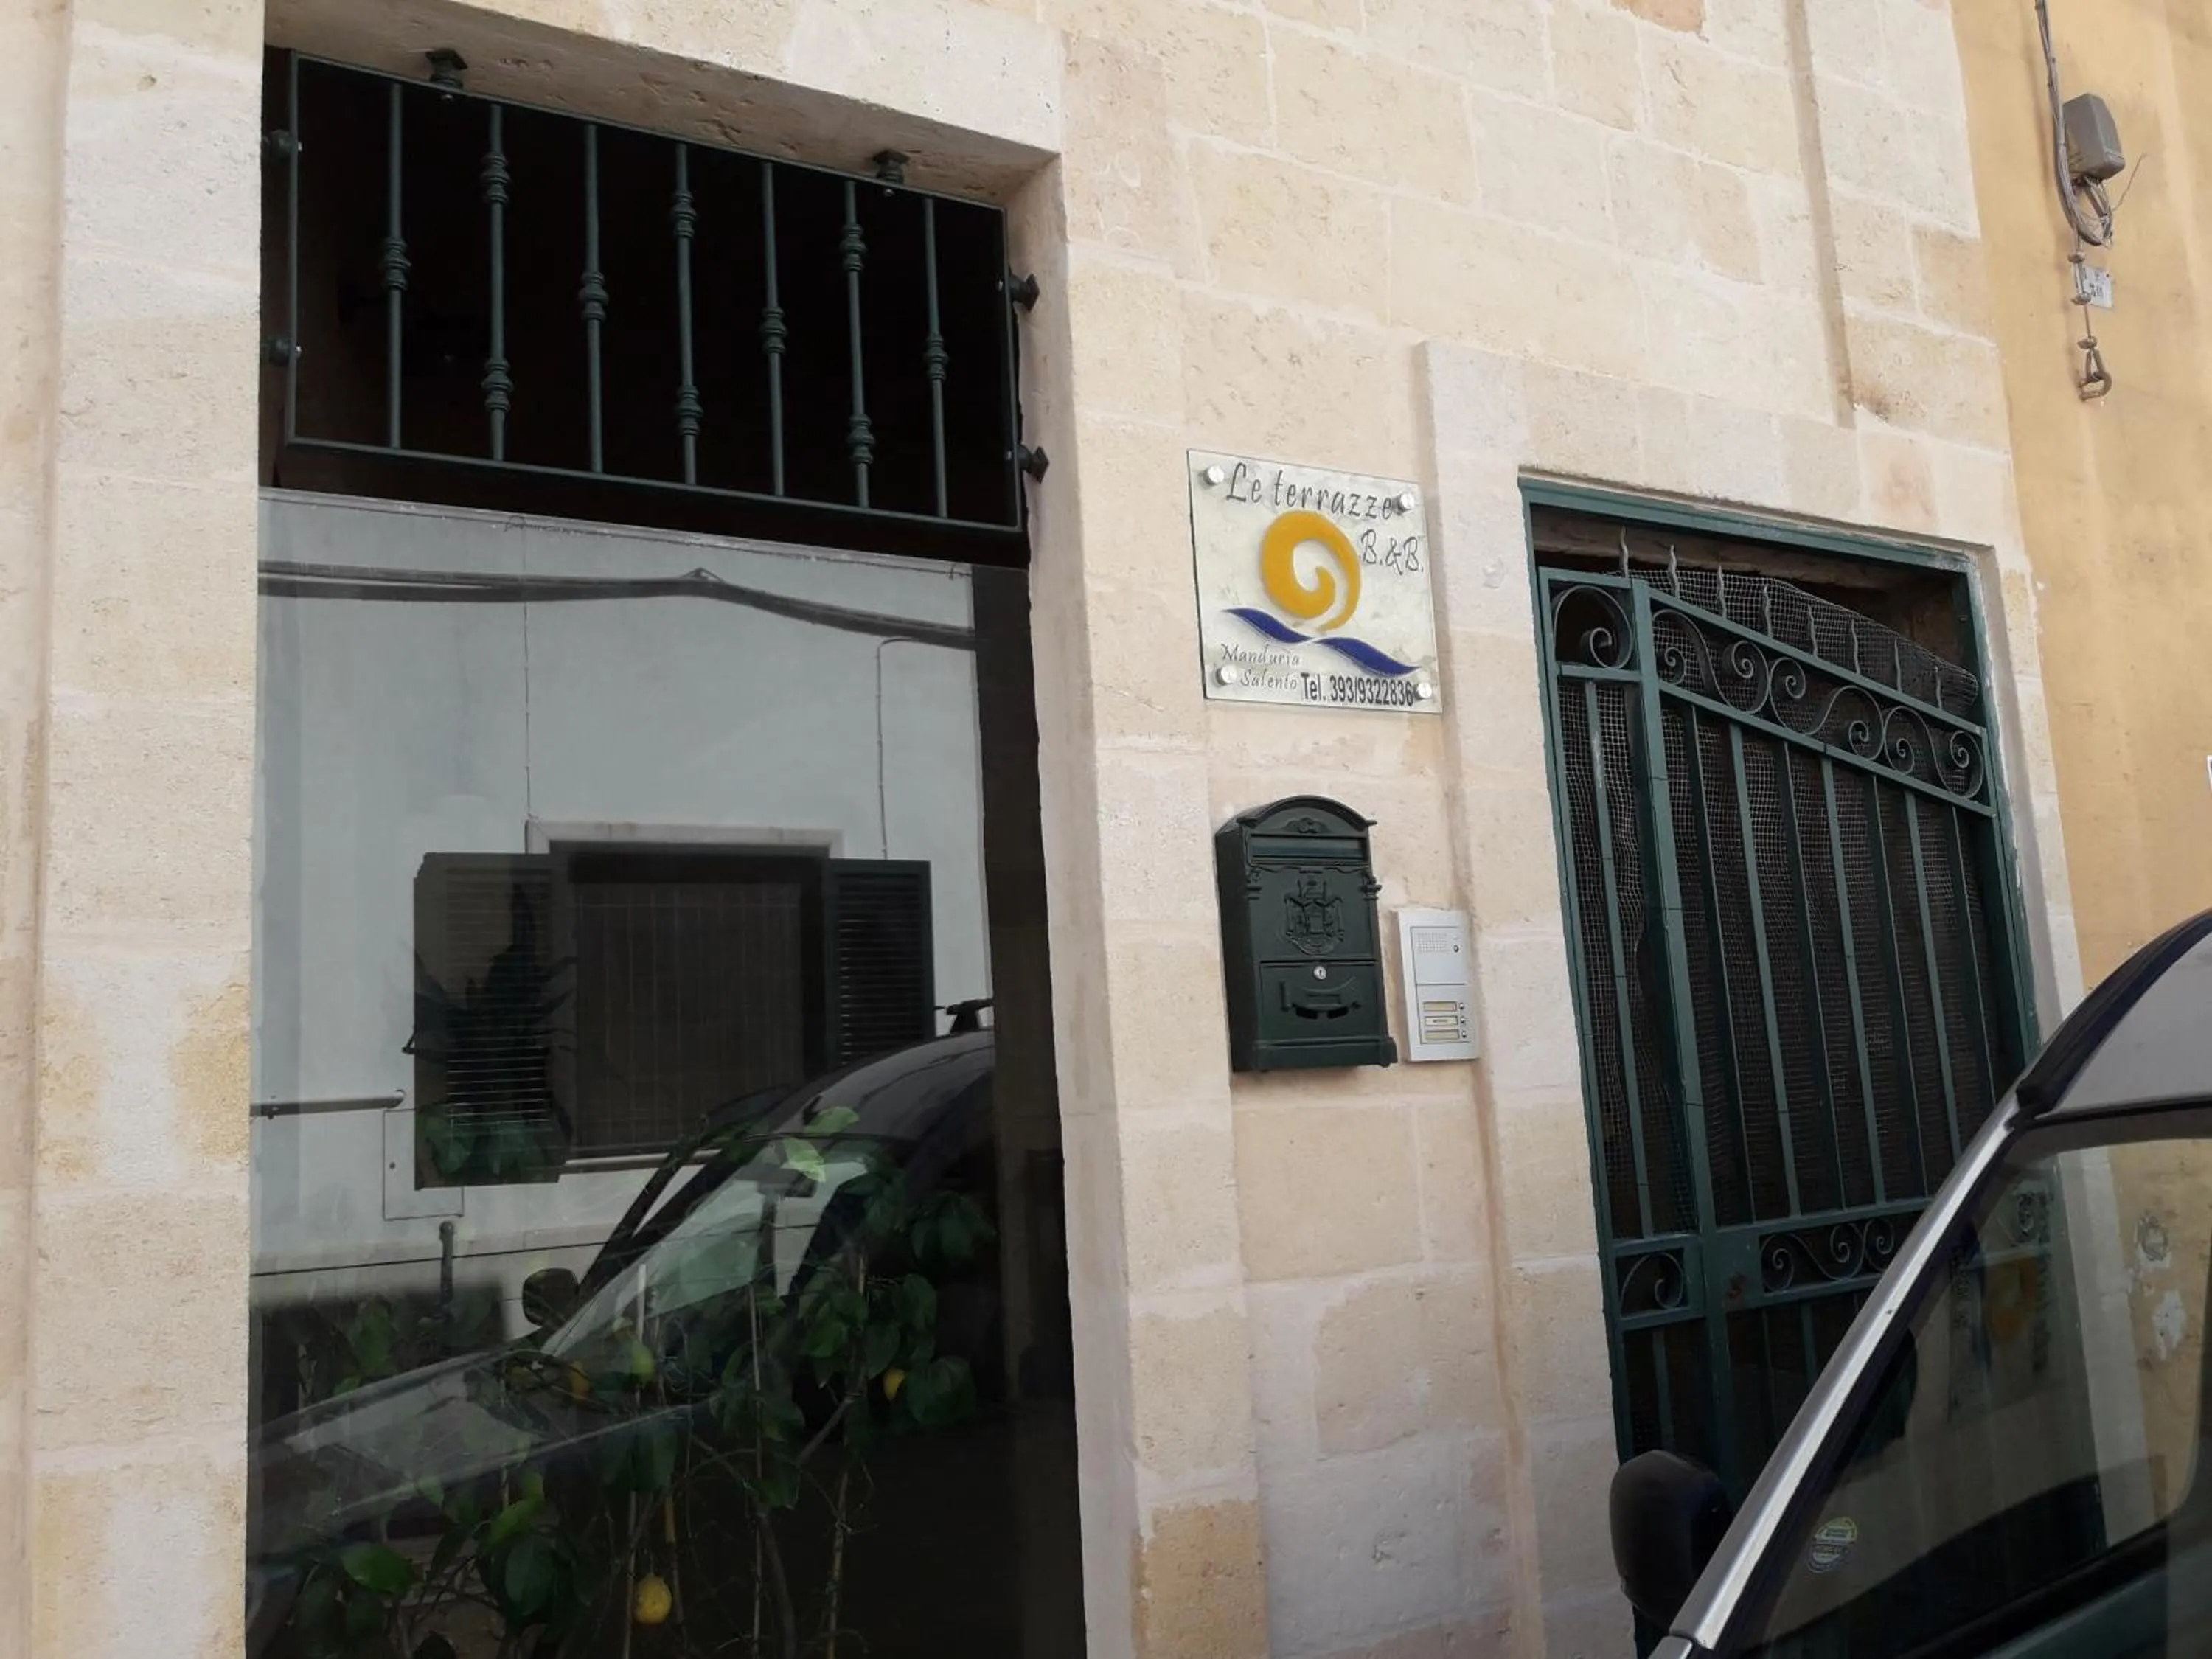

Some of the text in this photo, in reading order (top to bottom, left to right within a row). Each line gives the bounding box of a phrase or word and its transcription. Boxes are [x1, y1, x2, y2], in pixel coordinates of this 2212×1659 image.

[1225, 461, 1394, 521] Le terrazze
[1220, 643, 1300, 666] Manduria
[1239, 668, 1298, 690] Salento
[1300, 672, 1326, 701] Tel.
